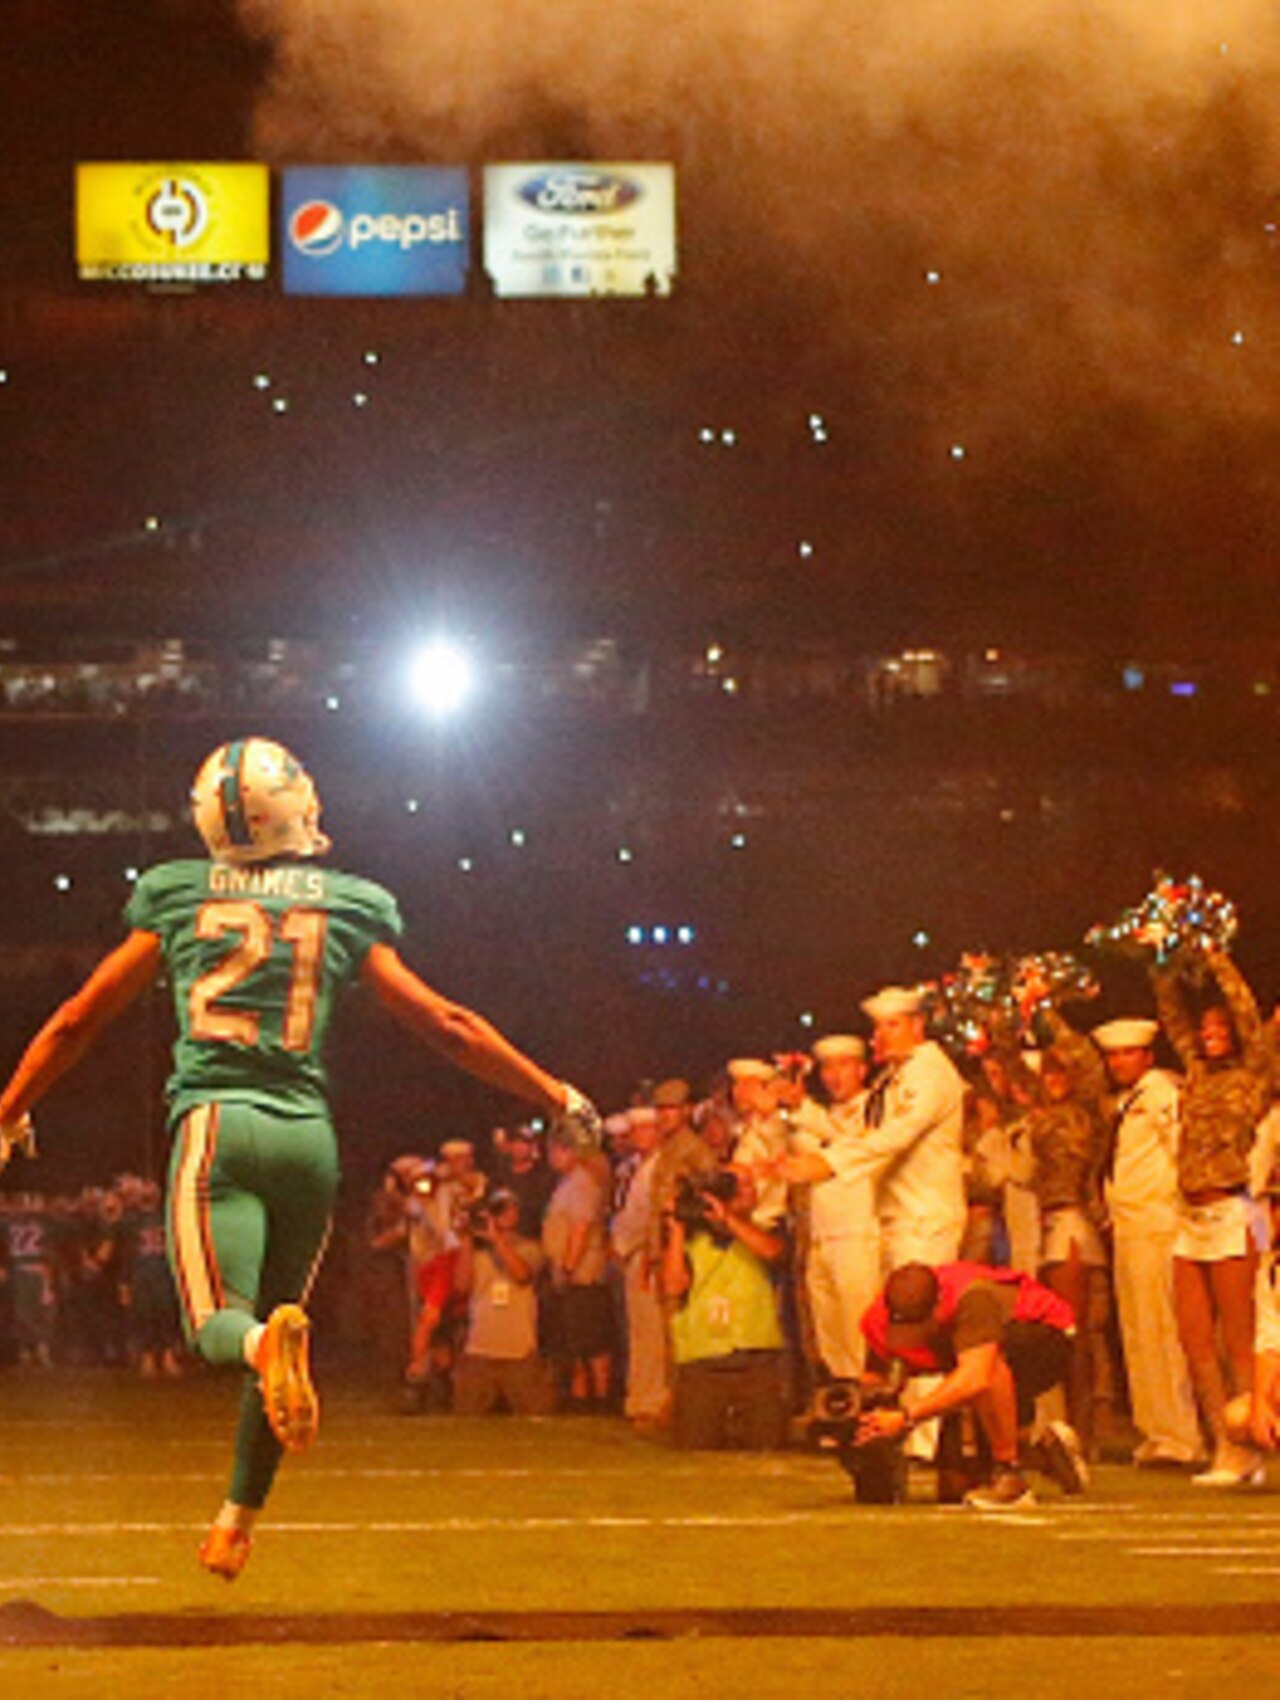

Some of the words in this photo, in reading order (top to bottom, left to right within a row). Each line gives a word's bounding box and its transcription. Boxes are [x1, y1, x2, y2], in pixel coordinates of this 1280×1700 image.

[350, 207, 461, 250] pepsi
[209, 864, 324, 900] GRIMES
[189, 899, 328, 1052] 21
